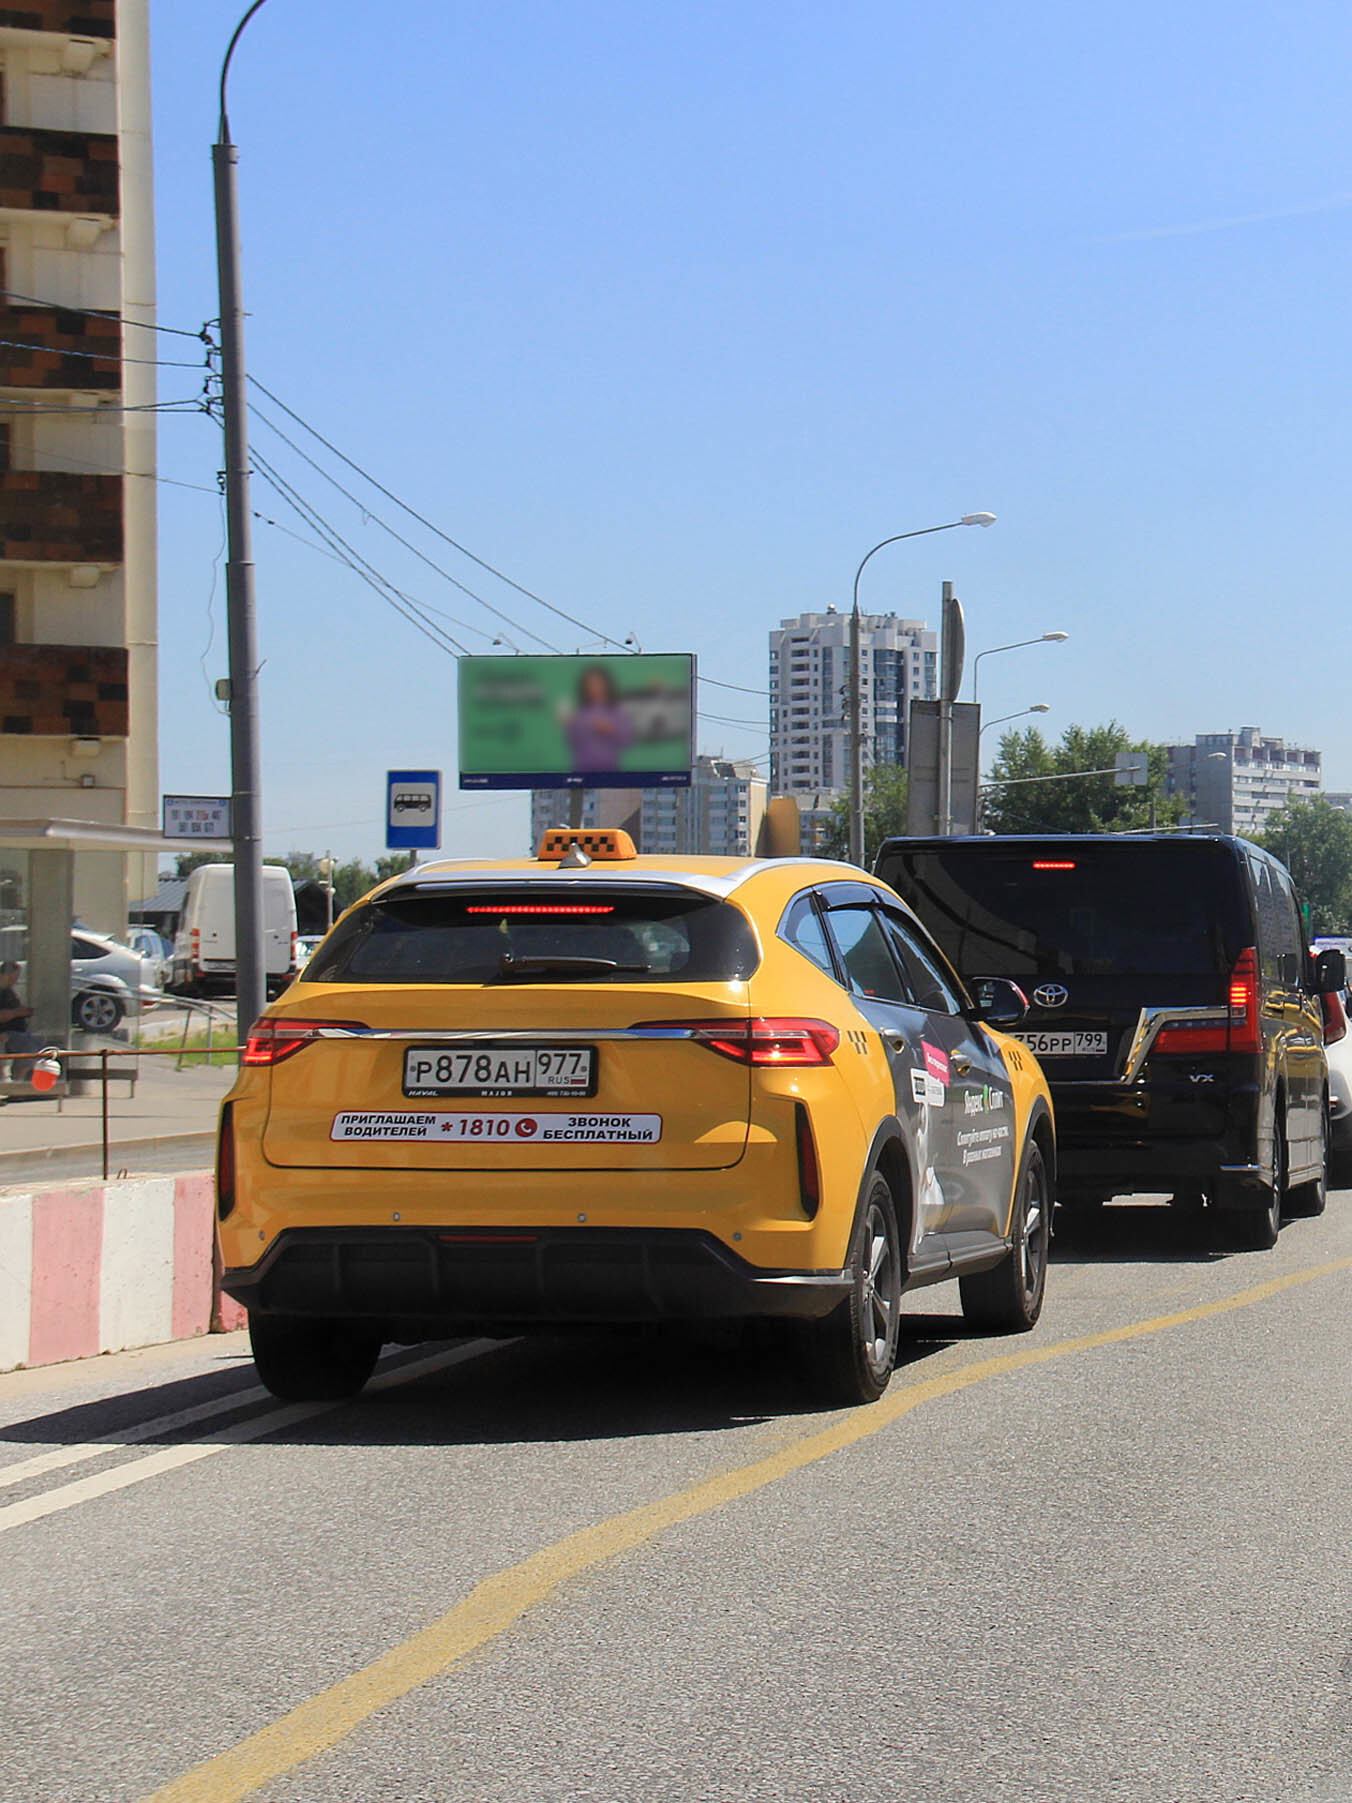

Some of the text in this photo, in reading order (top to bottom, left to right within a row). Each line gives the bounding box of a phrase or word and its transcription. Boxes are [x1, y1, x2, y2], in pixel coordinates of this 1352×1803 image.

[1077, 1033, 1102, 1046] 799
[416, 1053, 582, 1083] Р878АН 977
[548, 1076, 570, 1085] RUS
[1189, 1074, 1215, 1083] VX
[340, 1114, 436, 1125] ПРИГЛАШАЕМ
[567, 1117, 631, 1128] ЗВОНОК
[344, 1125, 428, 1137] ВОДИТЕЛЕЙ
[543, 1127, 653, 1140] БЕСПЛАТНЫЙ
